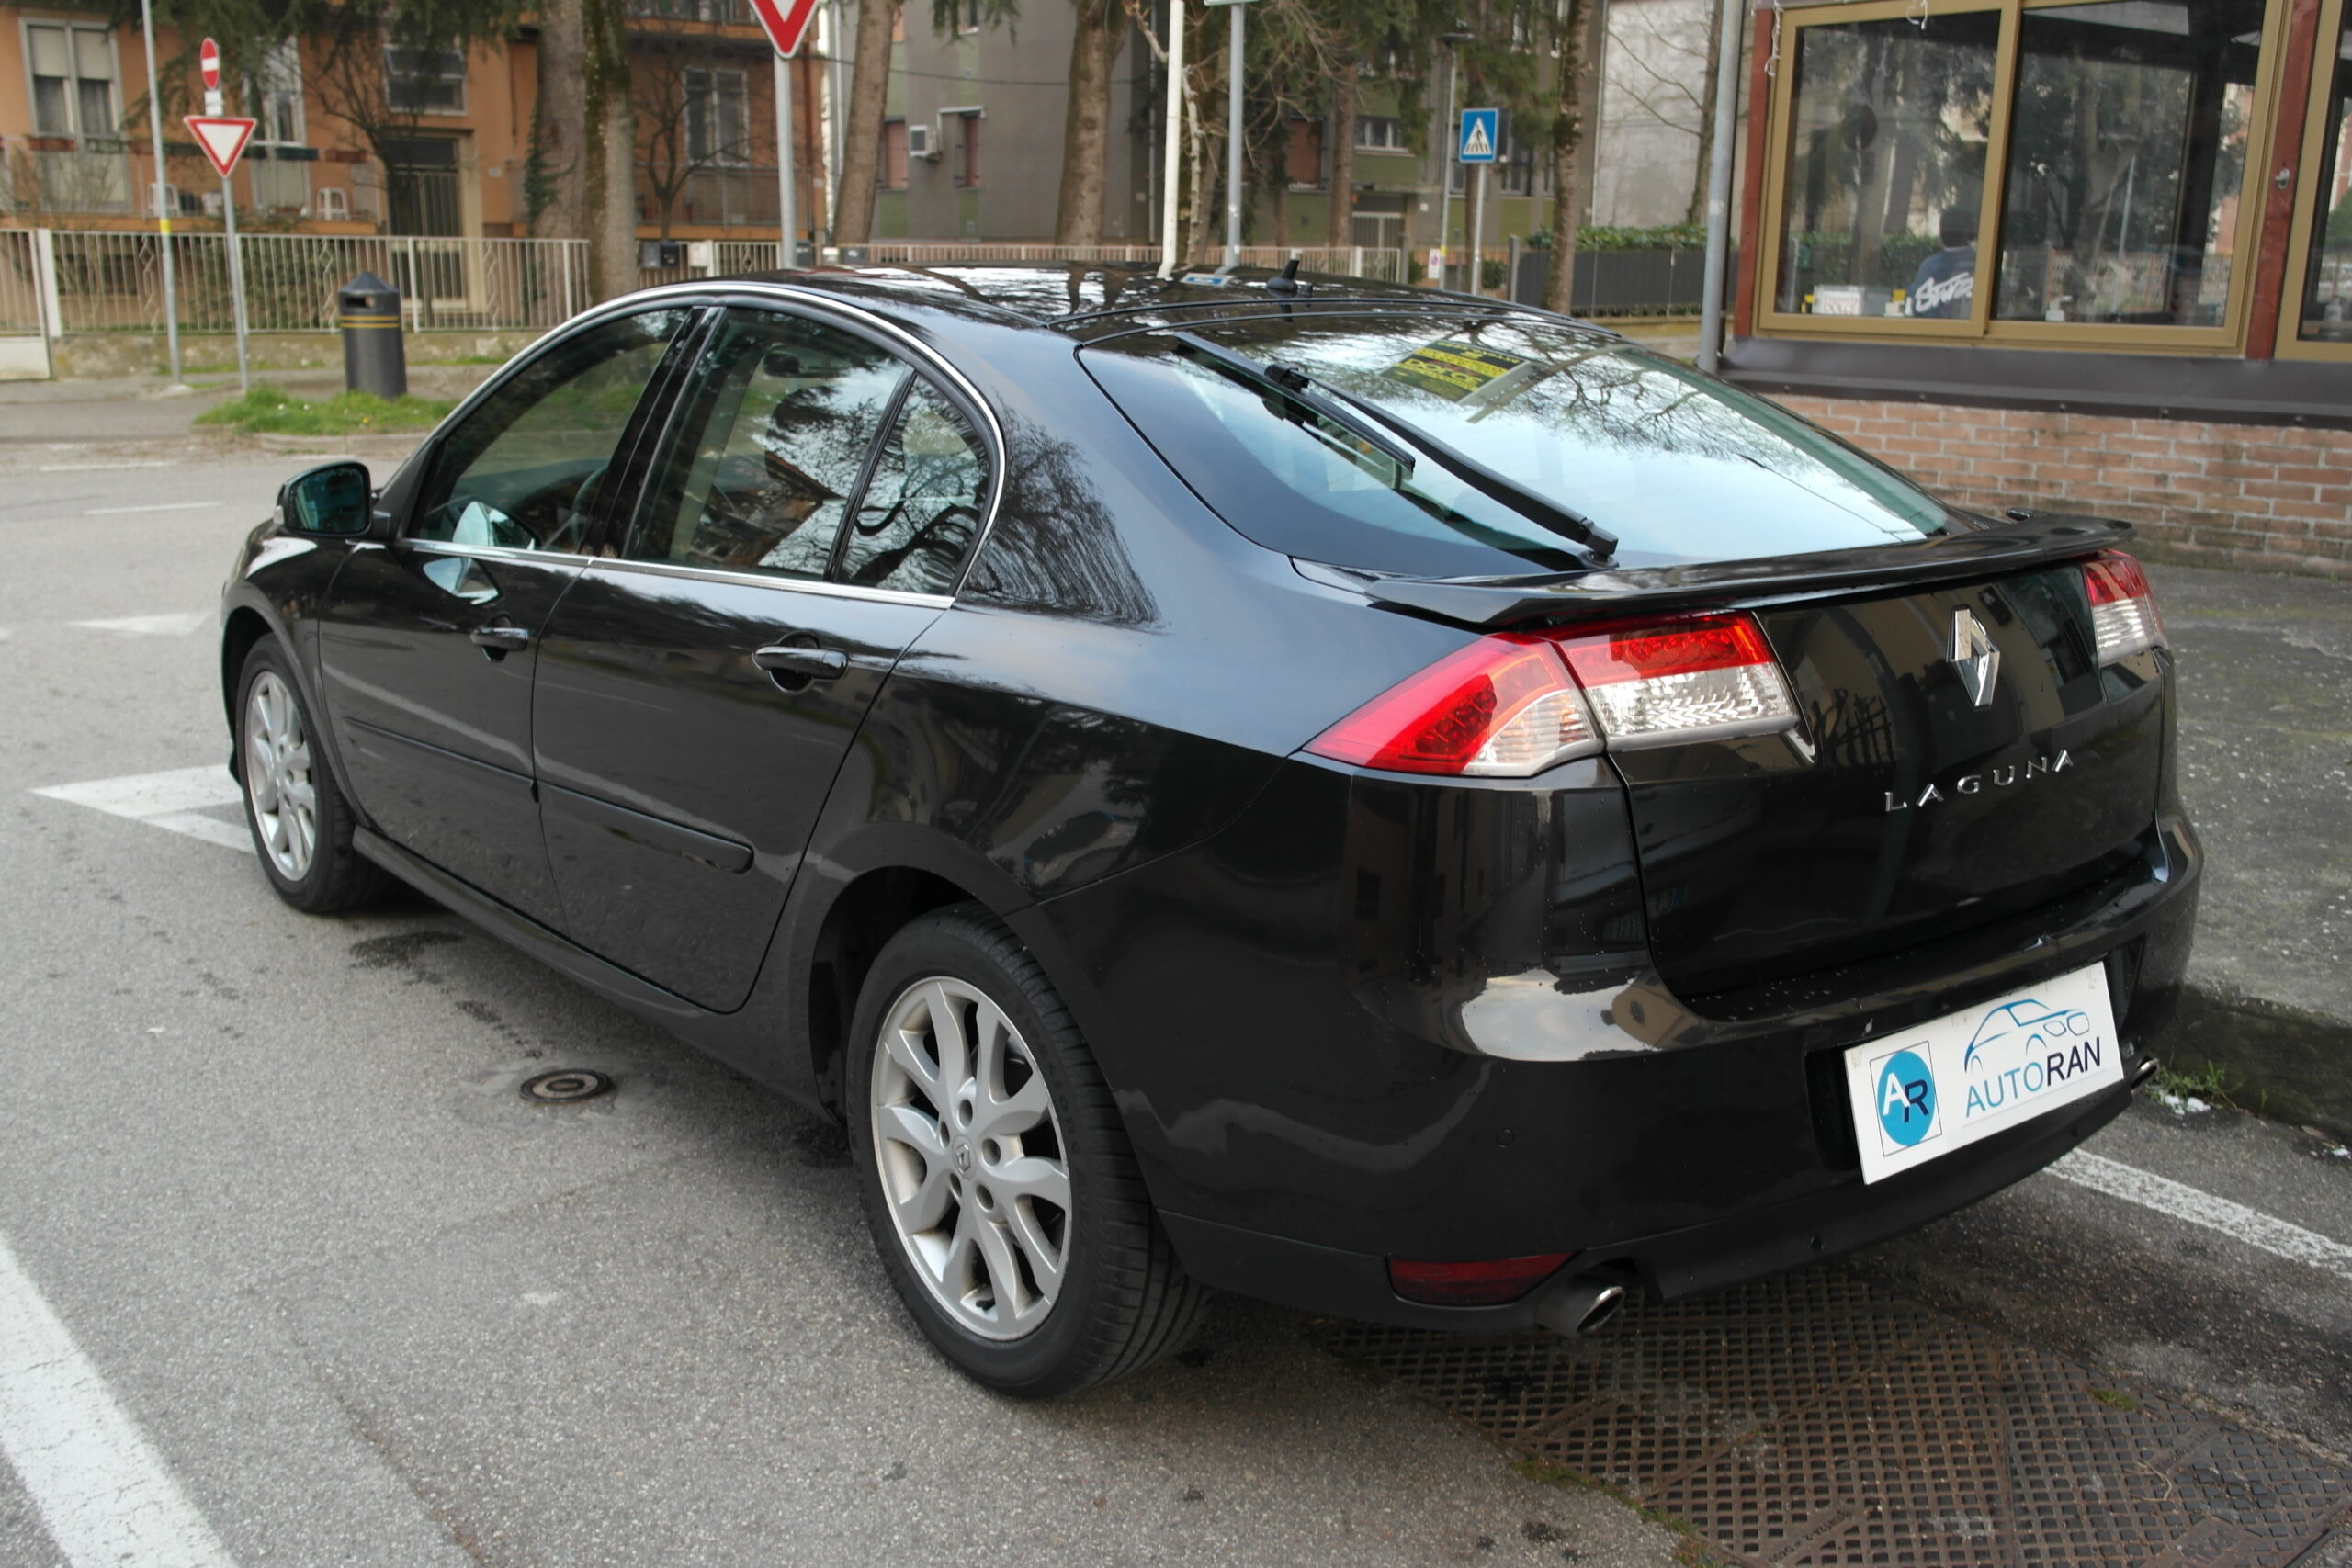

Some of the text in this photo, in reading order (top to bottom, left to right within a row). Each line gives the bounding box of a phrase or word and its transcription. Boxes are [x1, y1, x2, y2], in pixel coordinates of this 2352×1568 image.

[1884, 750, 2074, 811] LAGUNA
[1882, 1072, 1930, 1123] AR
[1965, 1036, 2101, 1118] AUTORAN
